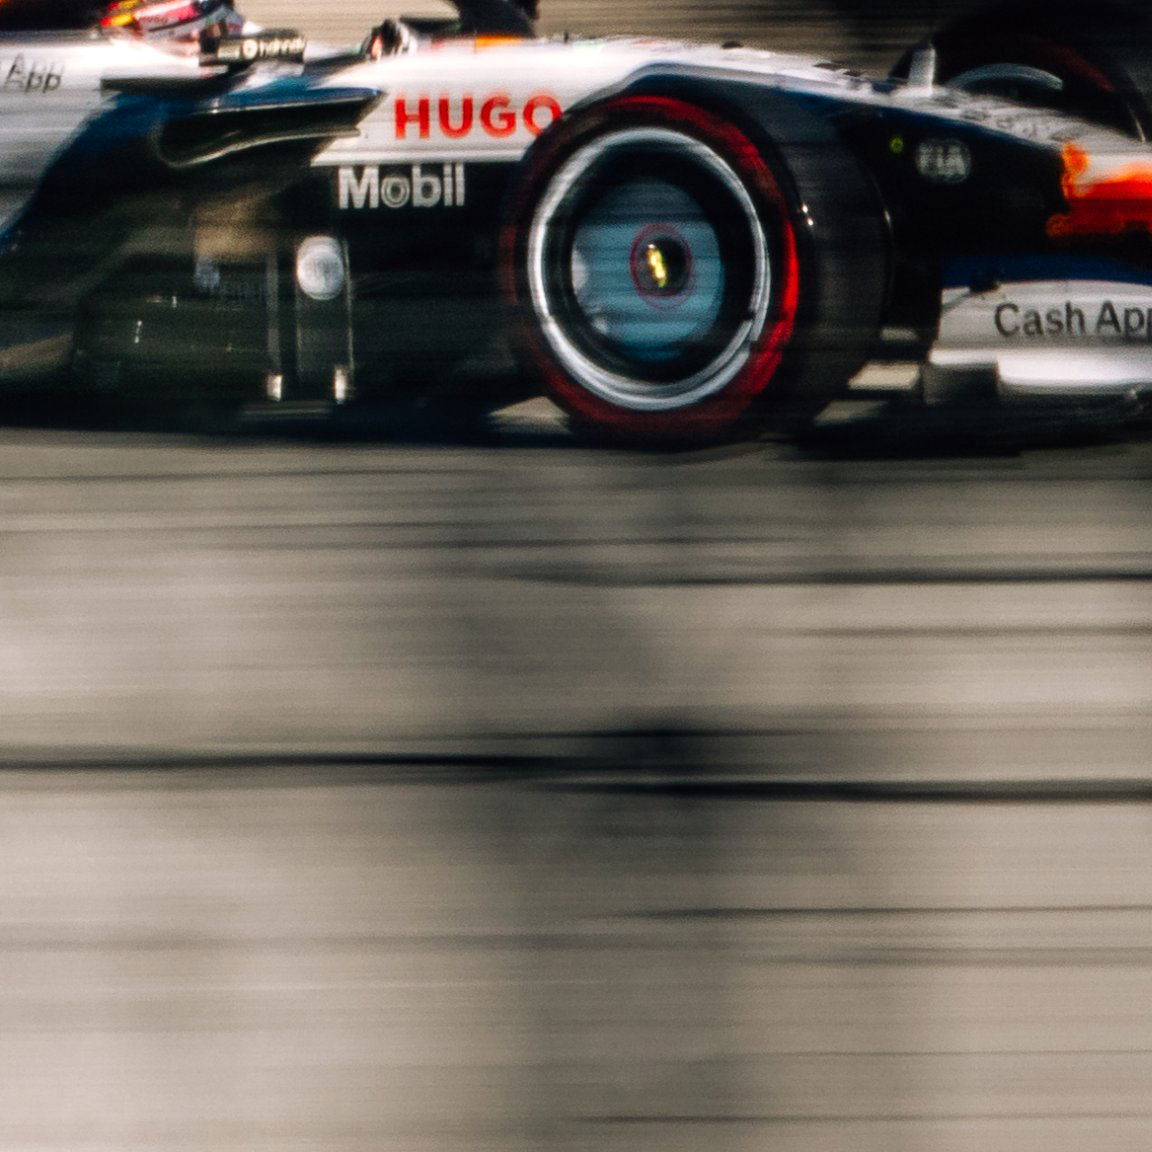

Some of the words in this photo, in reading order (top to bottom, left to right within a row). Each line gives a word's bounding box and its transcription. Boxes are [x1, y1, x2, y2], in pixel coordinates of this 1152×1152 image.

[4, 52, 64, 93] App
[395, 92, 563, 140] HUGO
[917, 144, 968, 177] FIA
[338, 164, 466, 209] Mobil
[994, 301, 1086, 336] Cash
[1097, 301, 1152, 345] Ap
